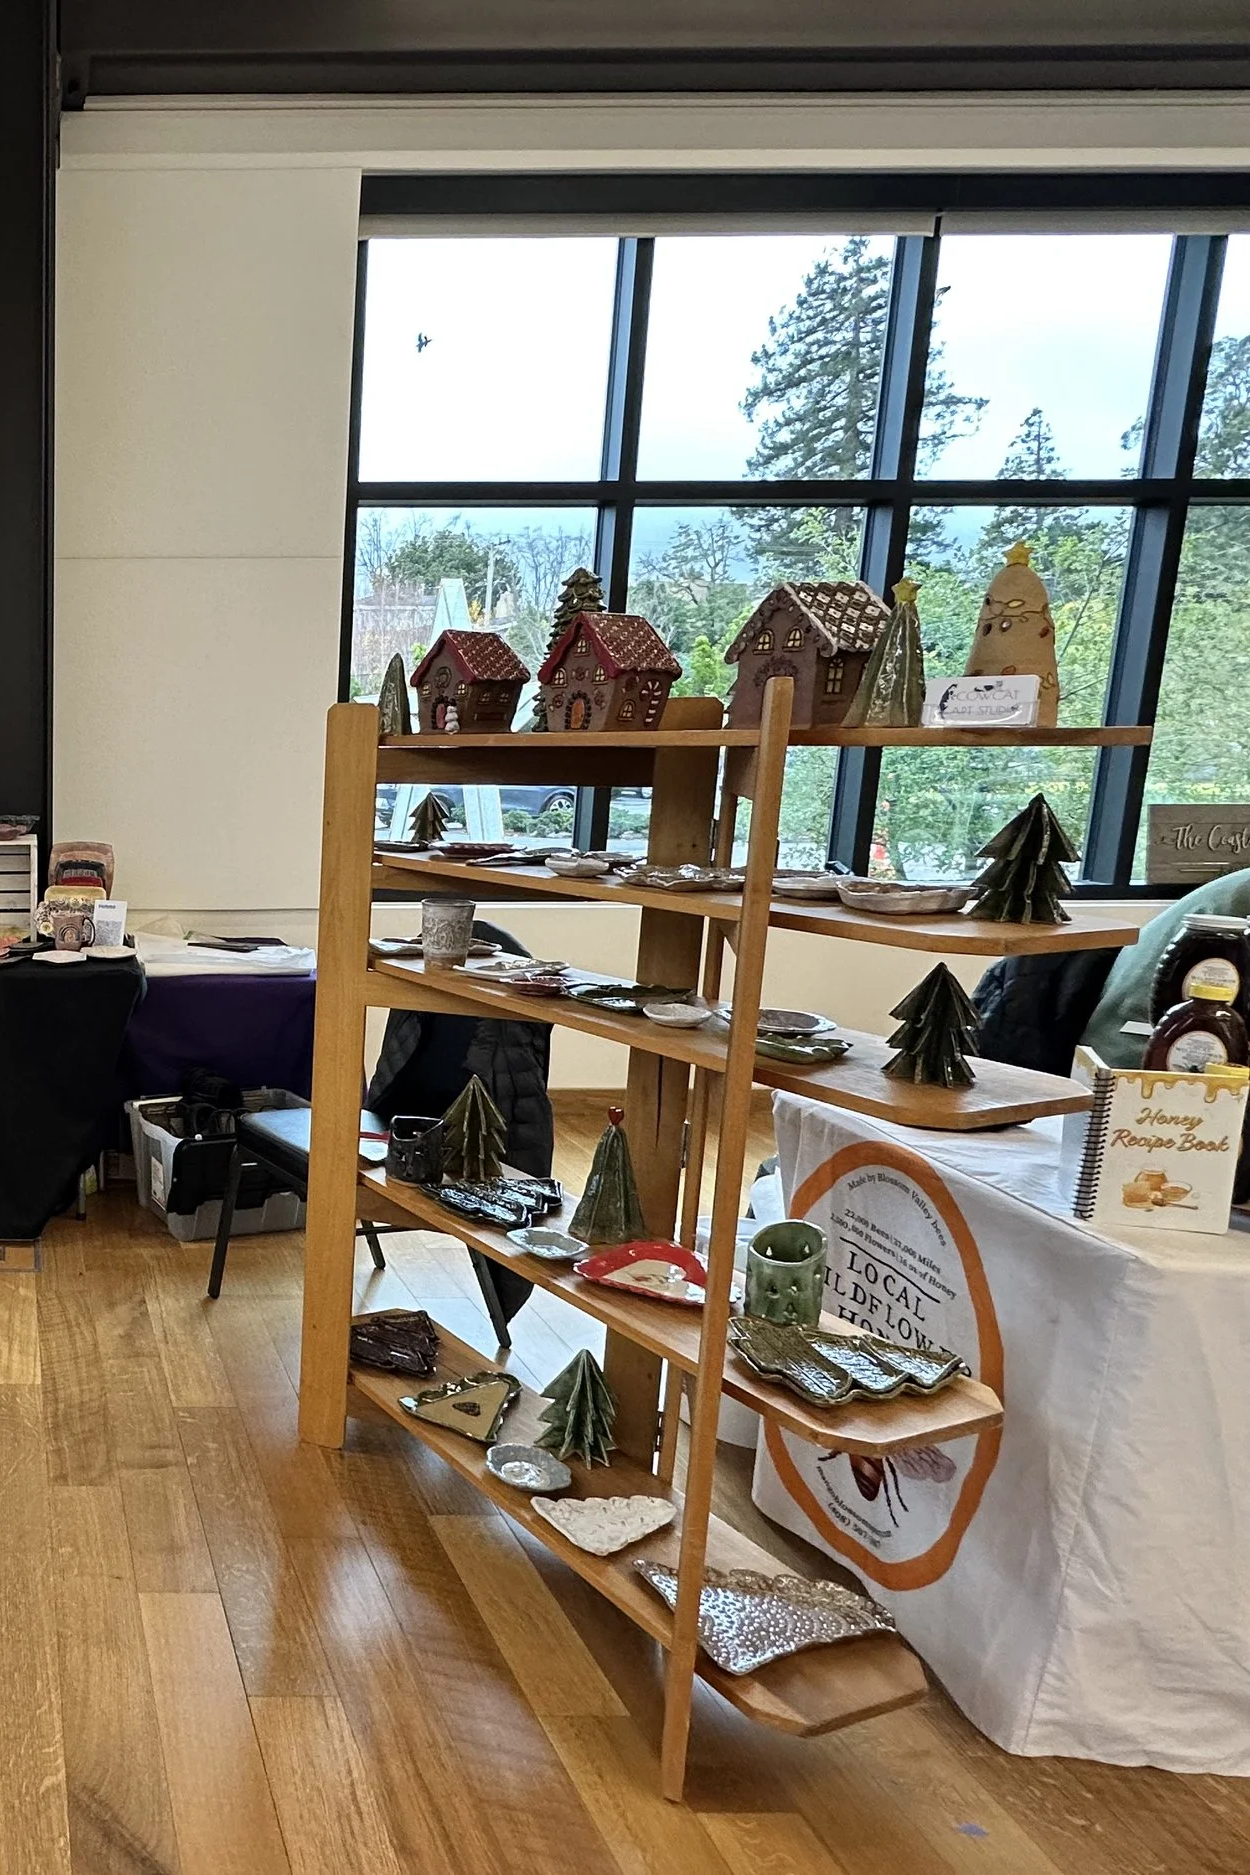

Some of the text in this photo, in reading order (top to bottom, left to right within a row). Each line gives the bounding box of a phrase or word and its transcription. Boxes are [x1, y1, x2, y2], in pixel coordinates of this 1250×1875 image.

[955, 690, 1020, 701] COWCAT
[1173, 823, 1250, 854] The Coast
[1135, 1107, 1203, 1131] Honey
[1110, 1128, 1230, 1153] Recipe Book
[911, 1191, 933, 1219] Valley
[931, 1220, 947, 1247] bees
[918, 1254, 942, 1274] Miles
[847, 1250, 926, 1322] LOCAL
